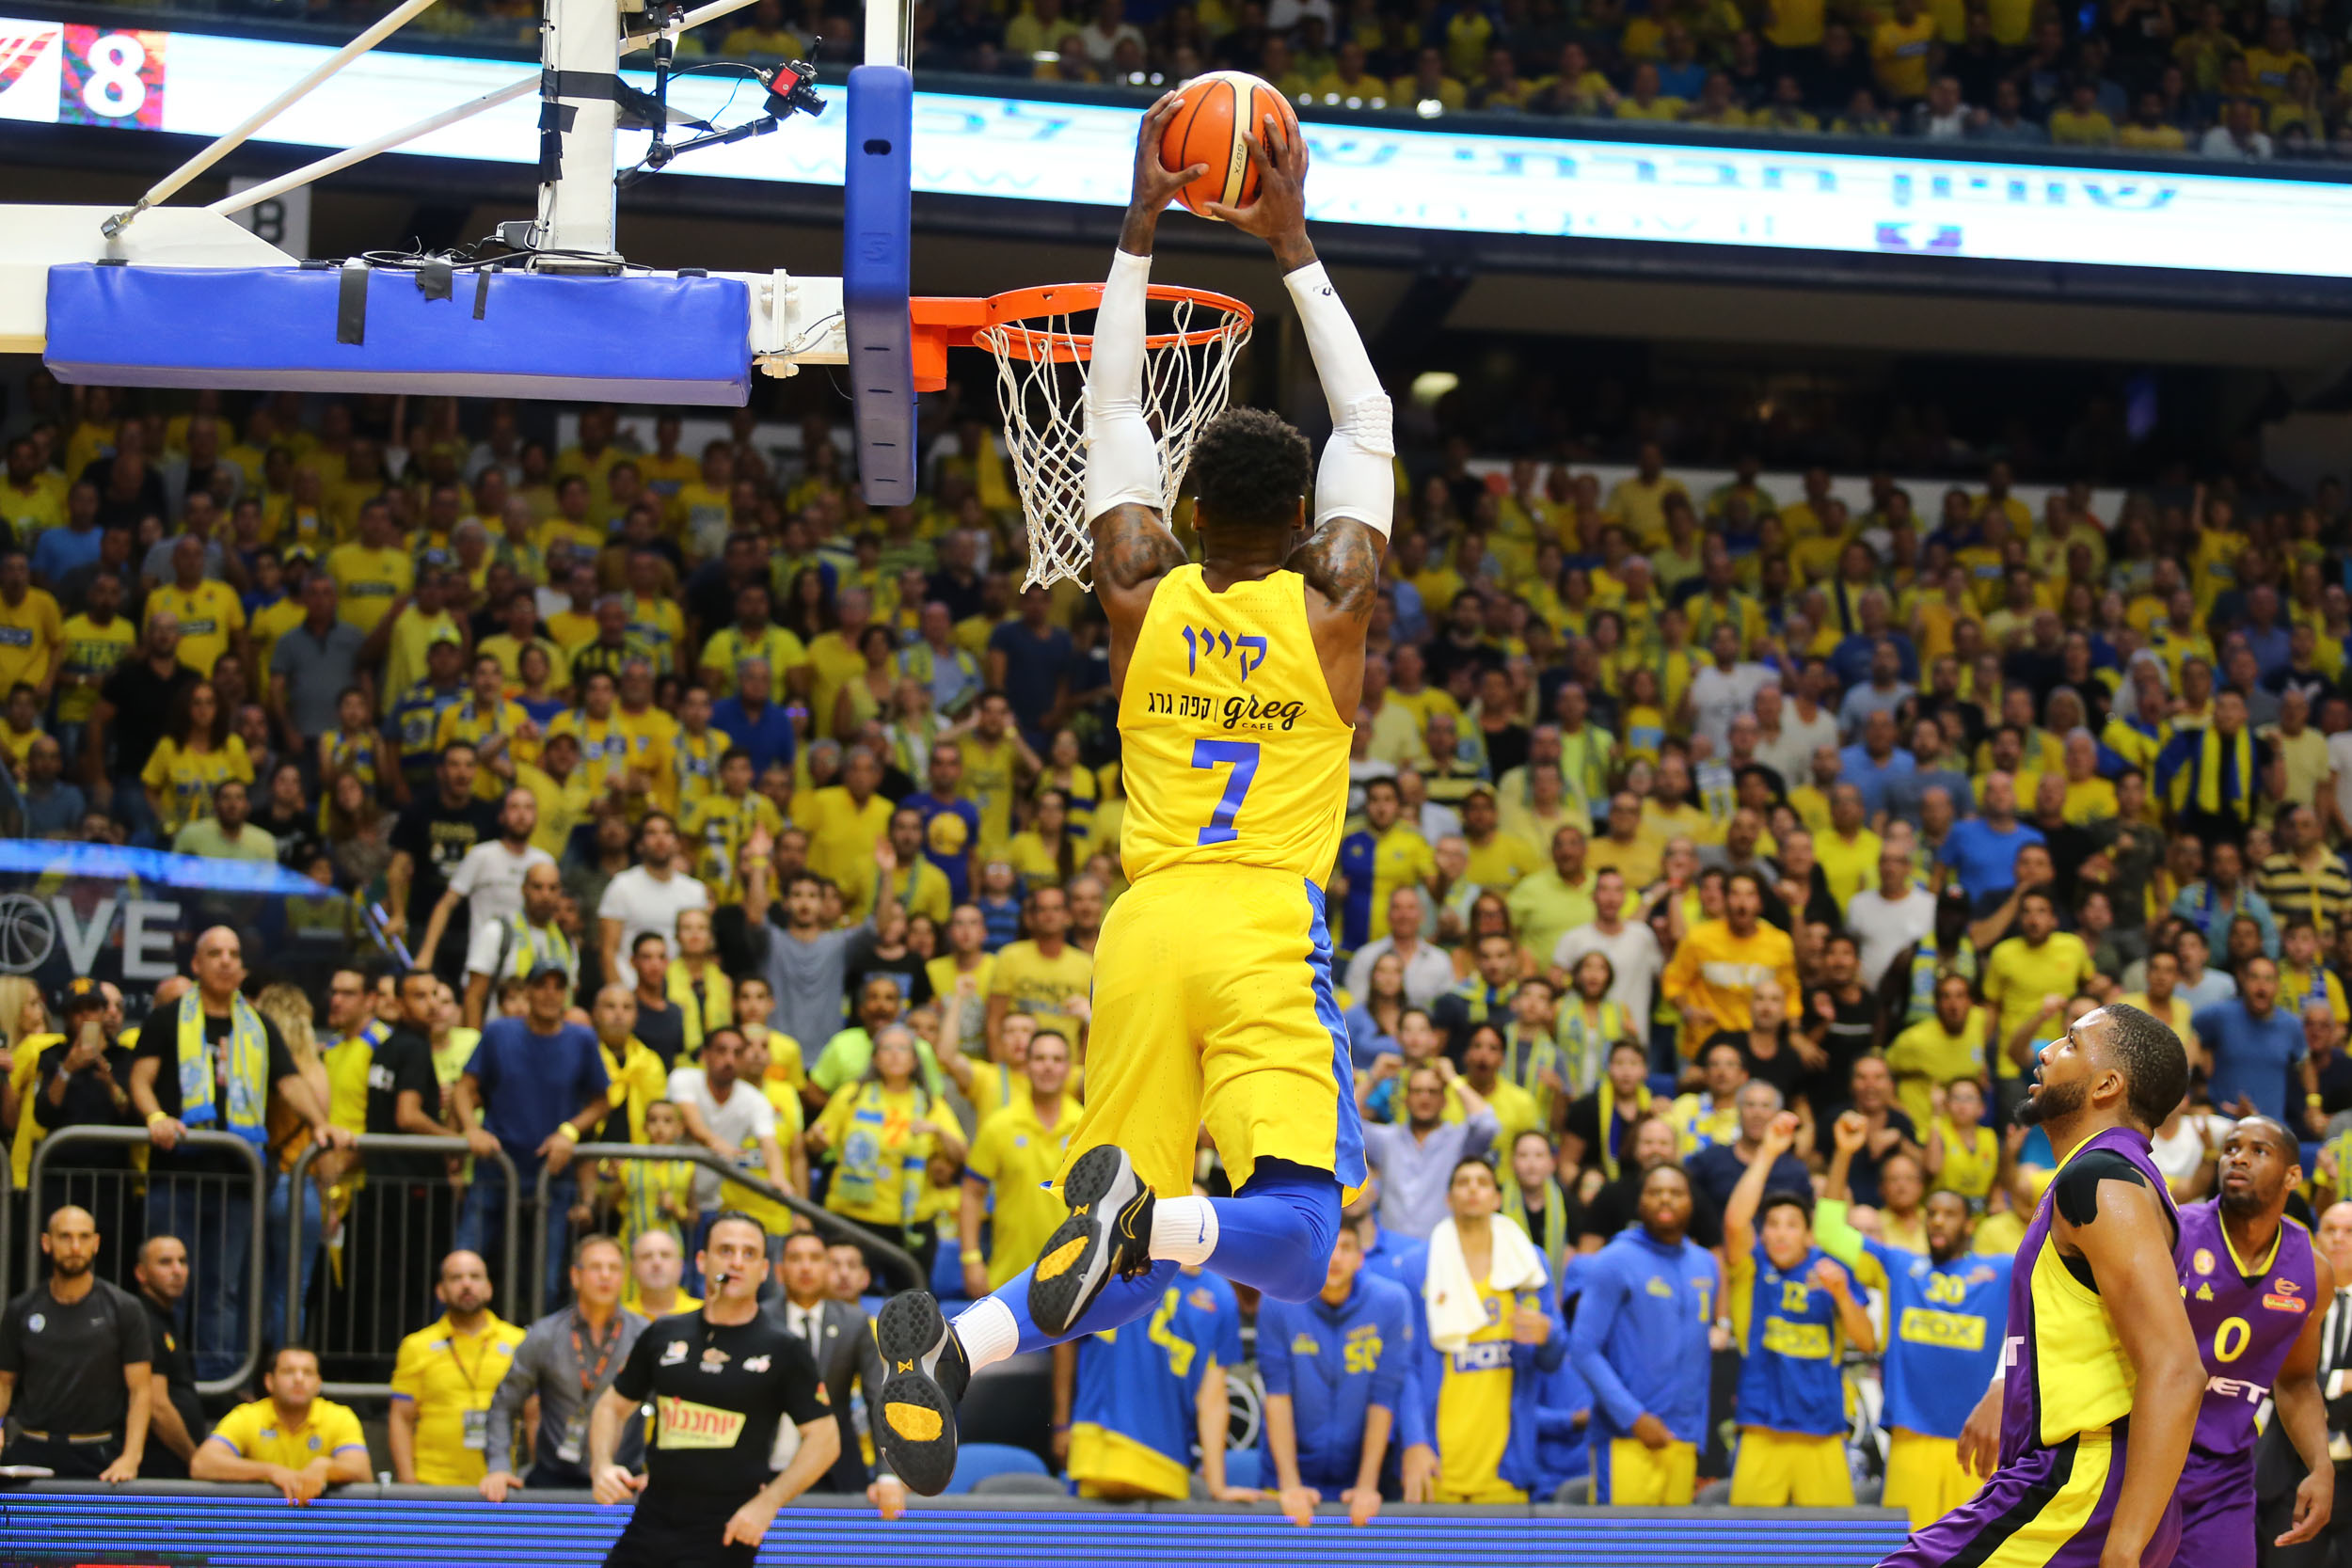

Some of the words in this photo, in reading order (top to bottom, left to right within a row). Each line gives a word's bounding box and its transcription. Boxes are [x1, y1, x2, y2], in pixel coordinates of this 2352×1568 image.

[83, 34, 146, 118] 8
[1233, 143, 1244, 174] GG7X
[1182, 625, 1267, 683] קיין
[1148, 692, 1172, 714] גרג
[1179, 694, 1212, 721] קפה
[1222, 694, 1307, 731] greg
[1241, 721, 1274, 731] CAFE
[1191, 738, 1261, 847] 7
[1781, 1280, 1809, 1314] 12
[1925, 1271, 1966, 1306] 30
[1910, 1315, 1974, 1342] FOX
[2214, 1316, 2251, 1363] 0
